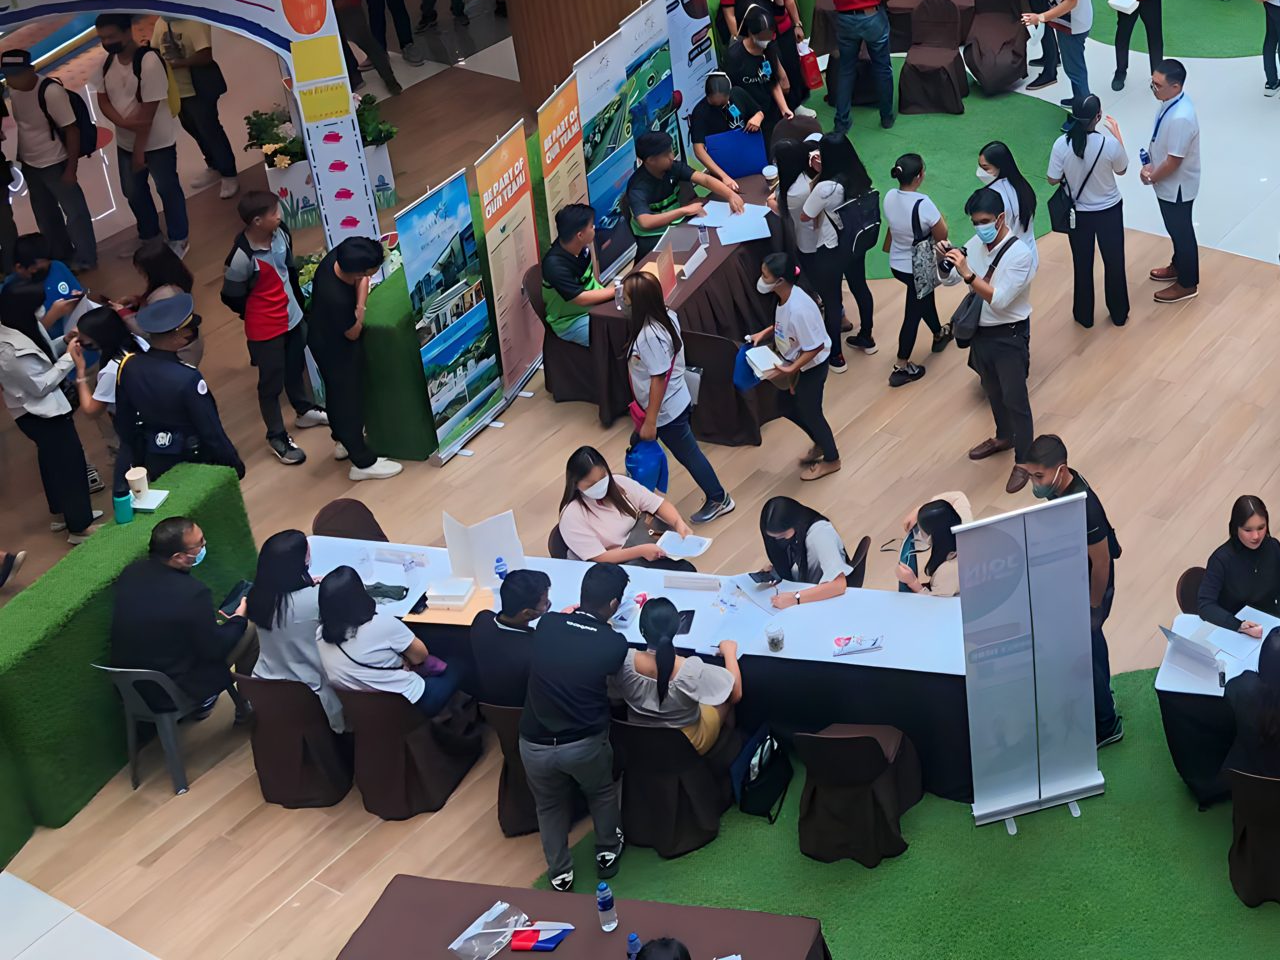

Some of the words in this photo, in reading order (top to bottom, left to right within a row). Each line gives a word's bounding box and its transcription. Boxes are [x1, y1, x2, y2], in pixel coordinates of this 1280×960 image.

[492, 167, 513, 196] PART
[514, 157, 524, 176] OF
[485, 195, 503, 219] OUR
